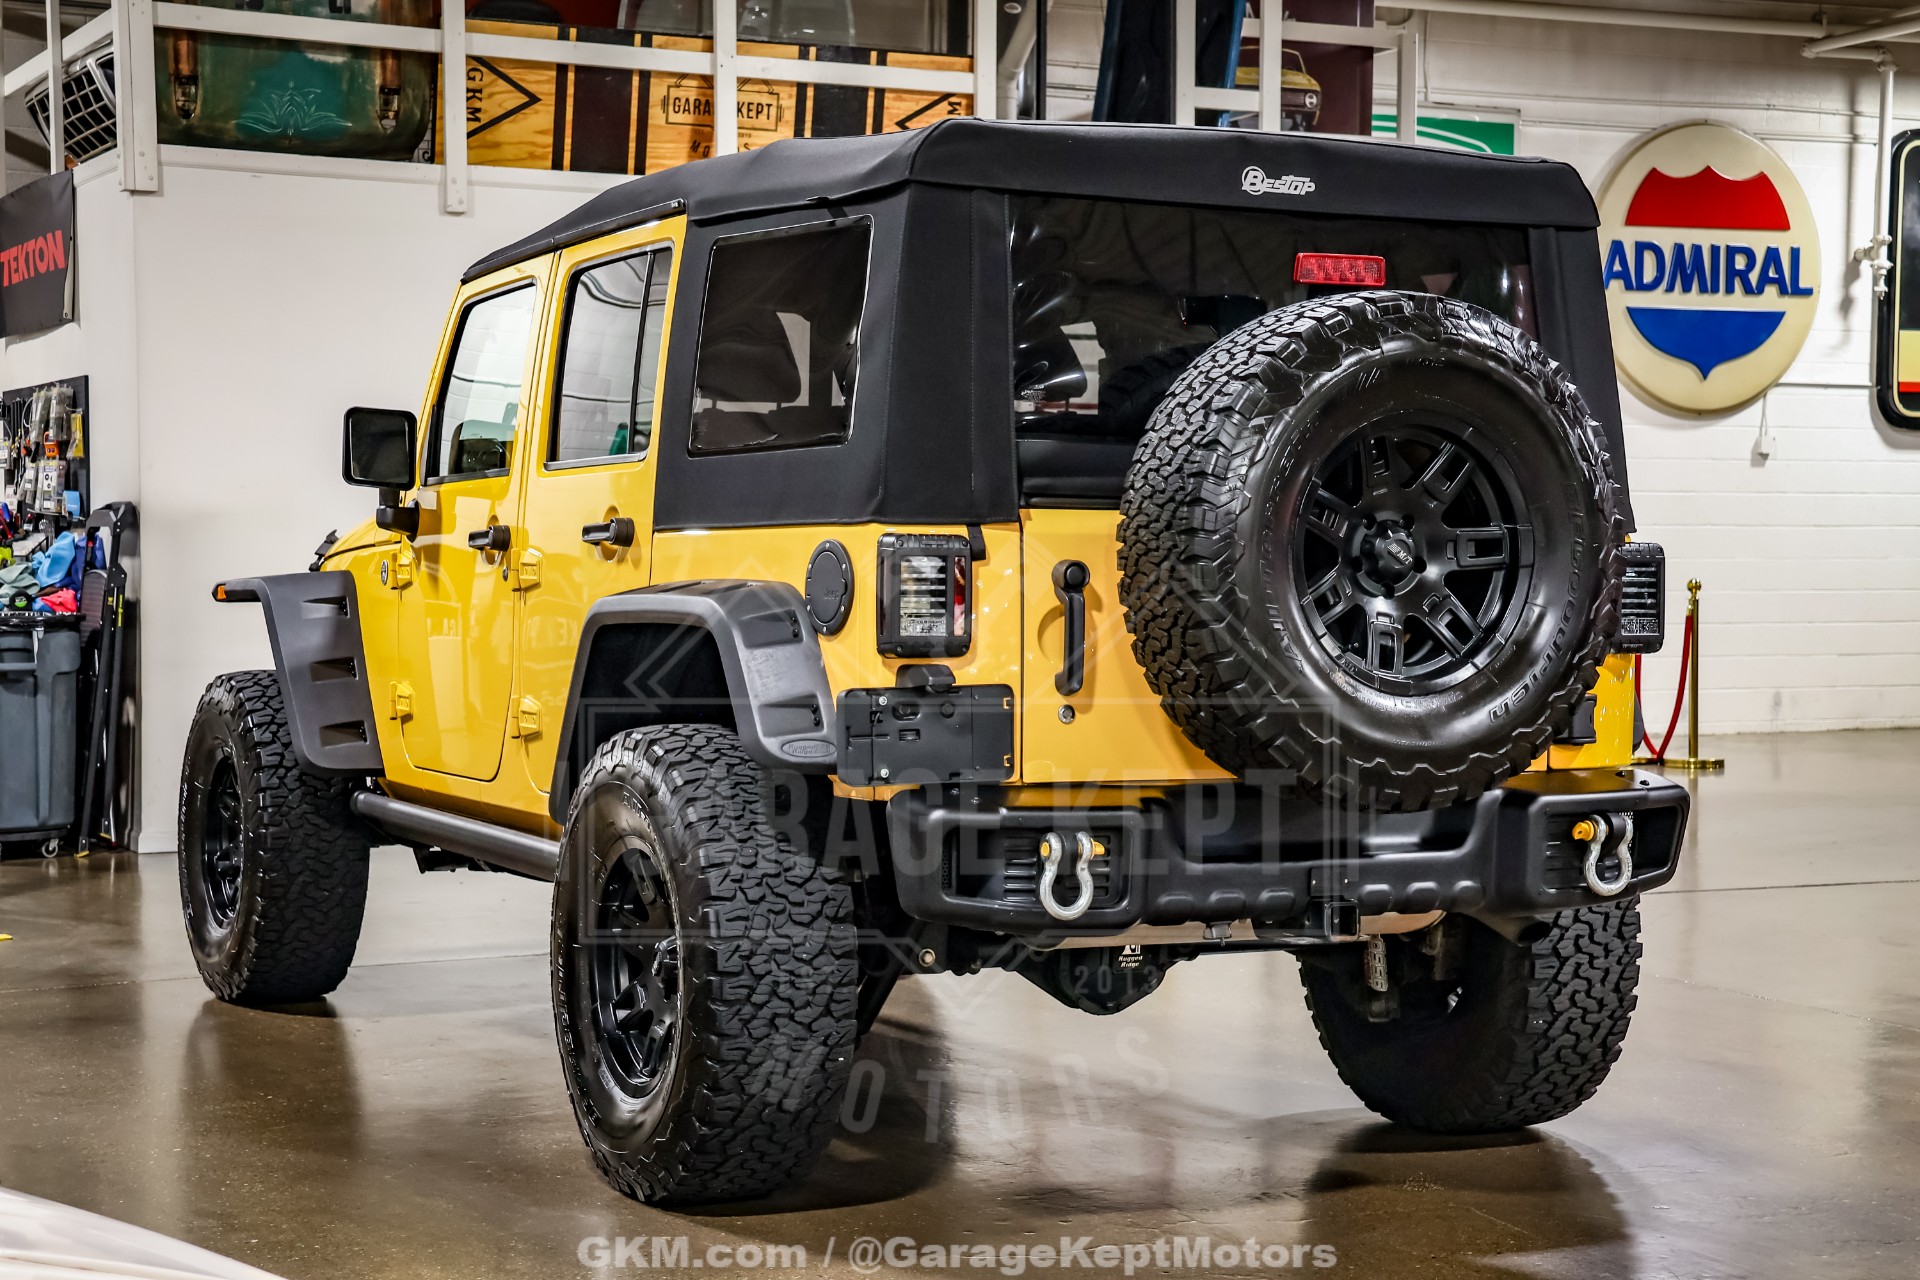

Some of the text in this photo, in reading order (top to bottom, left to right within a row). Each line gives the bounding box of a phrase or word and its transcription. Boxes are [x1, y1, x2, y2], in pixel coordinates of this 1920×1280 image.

[737, 101, 773, 120] KEPT
[0, 230, 66, 287] TEKTON
[1603, 240, 1814, 296] ADMIRAL
